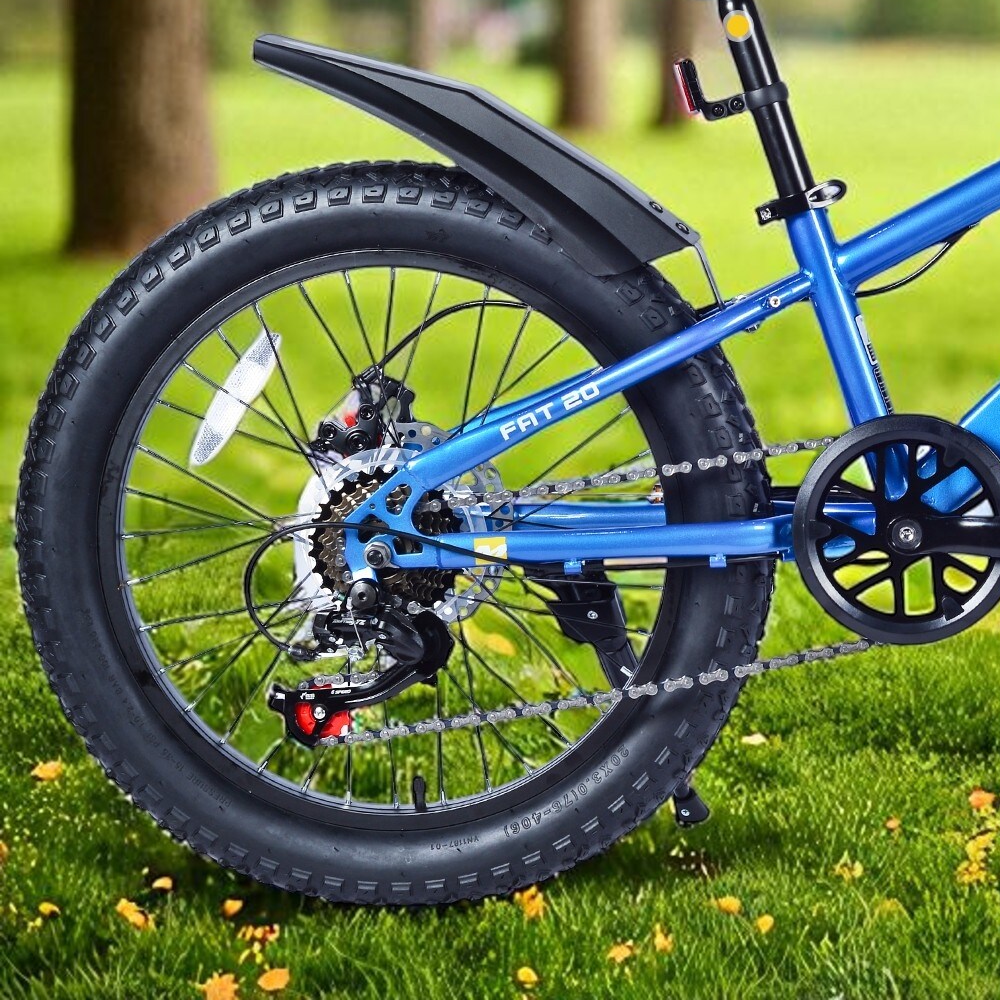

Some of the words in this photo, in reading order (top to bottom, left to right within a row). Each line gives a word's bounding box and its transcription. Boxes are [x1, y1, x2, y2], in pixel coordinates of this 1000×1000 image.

[499, 402, 554, 441] FAT
[561, 381, 600, 411] 20
[504, 744, 631, 838] 20X3.0(76-406)
